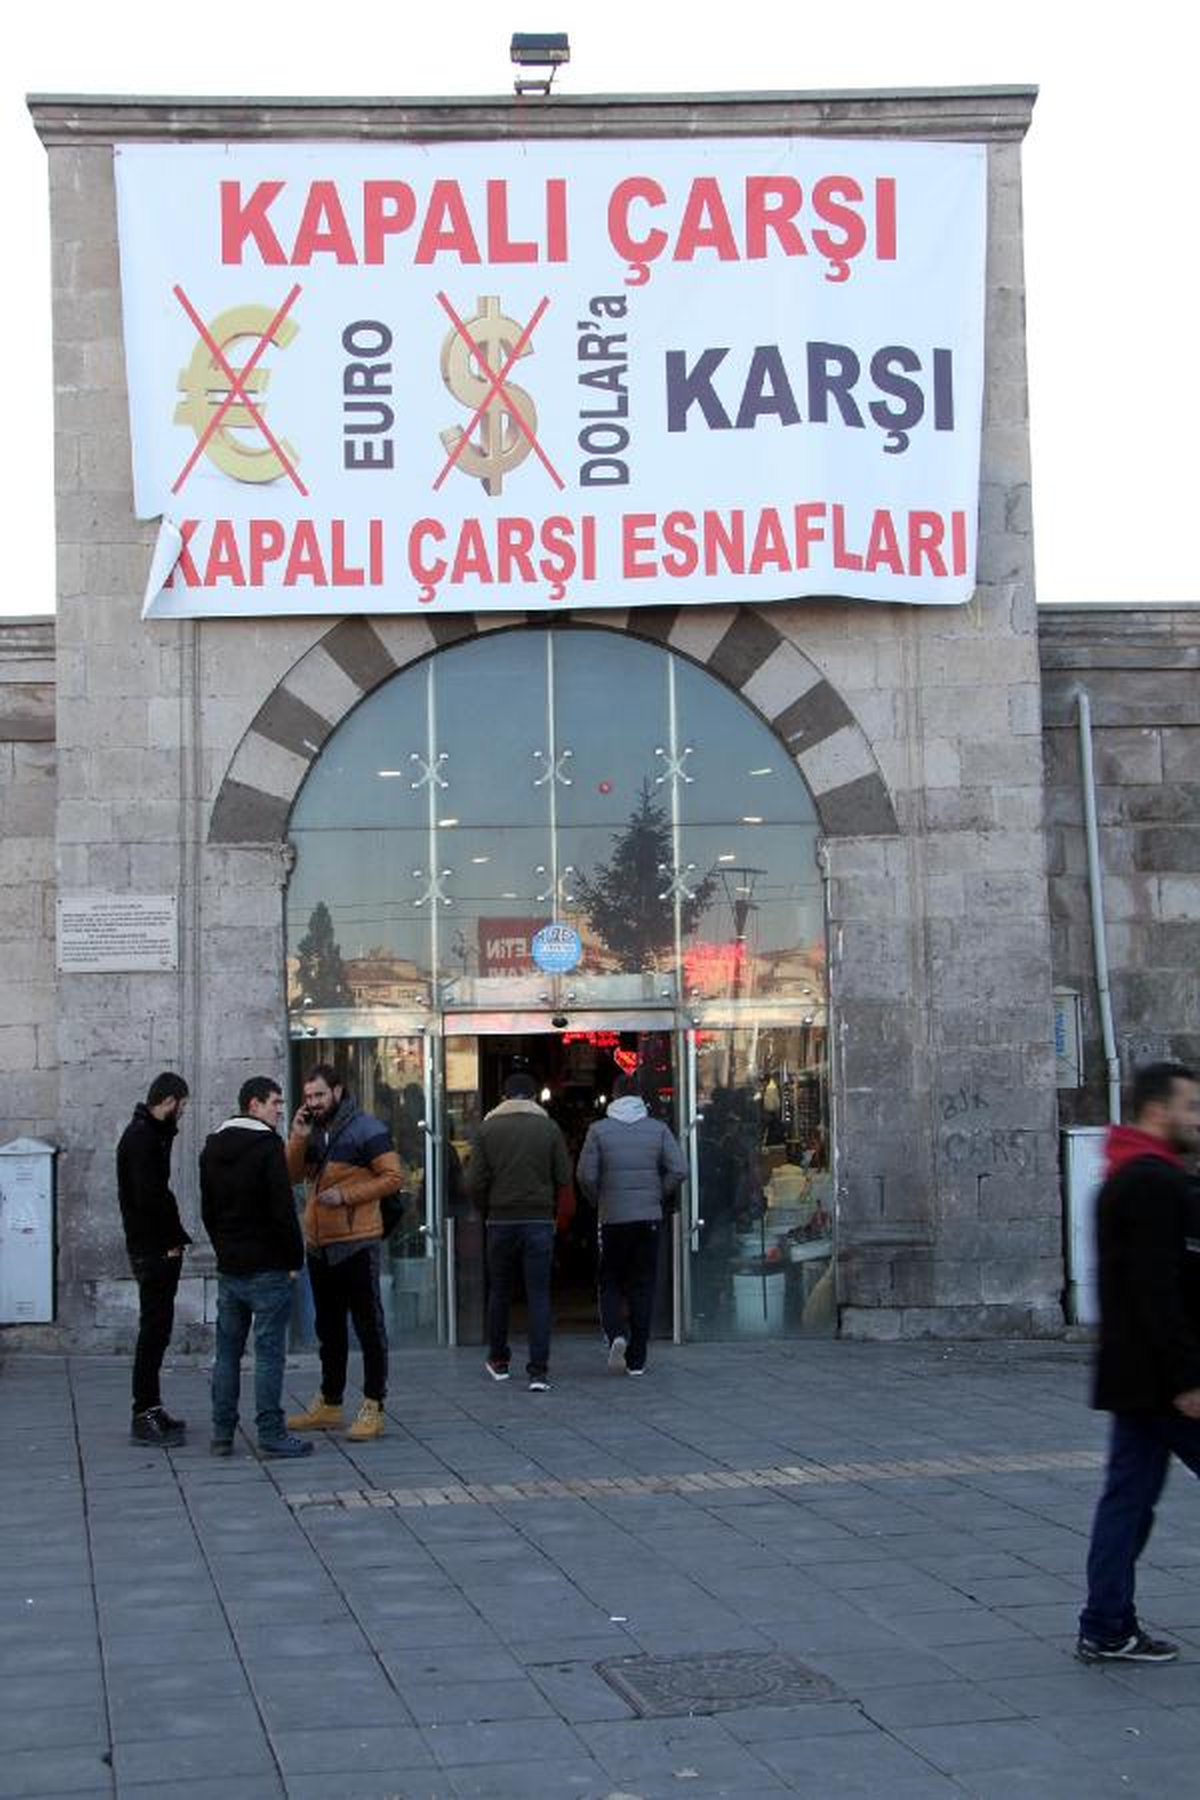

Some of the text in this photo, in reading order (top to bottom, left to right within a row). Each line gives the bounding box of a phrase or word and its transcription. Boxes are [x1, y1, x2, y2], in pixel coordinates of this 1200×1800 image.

[220, 176, 897, 285] KAPALI ÇARŞI
[342, 320, 394, 469] EURO
[578, 296, 629, 486] DOLAR'a
[666, 342, 953, 454] KARŞI
[164, 504, 967, 601] KAPALI ÇARŞI ESNAFLARI
